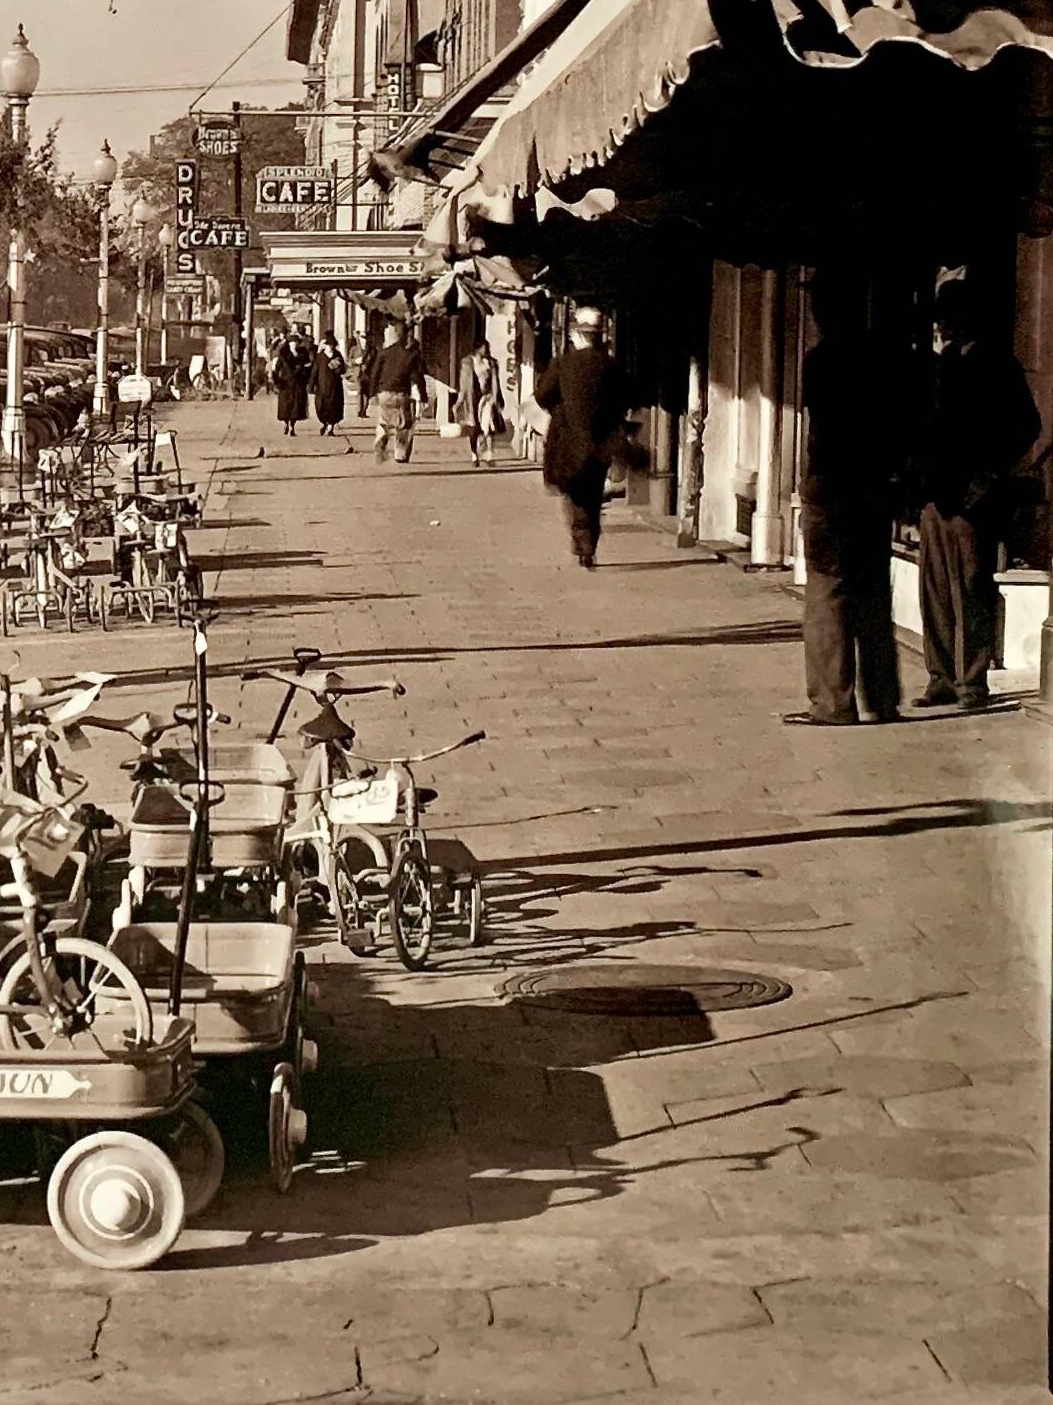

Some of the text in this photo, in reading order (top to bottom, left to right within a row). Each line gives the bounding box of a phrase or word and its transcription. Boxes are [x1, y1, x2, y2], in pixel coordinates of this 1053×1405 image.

[198, 140, 238, 155] SHOES
[262, 181, 329, 202] CAFE
[190, 229, 247, 245] CAFE
[364, 261, 404, 274] Shoe
